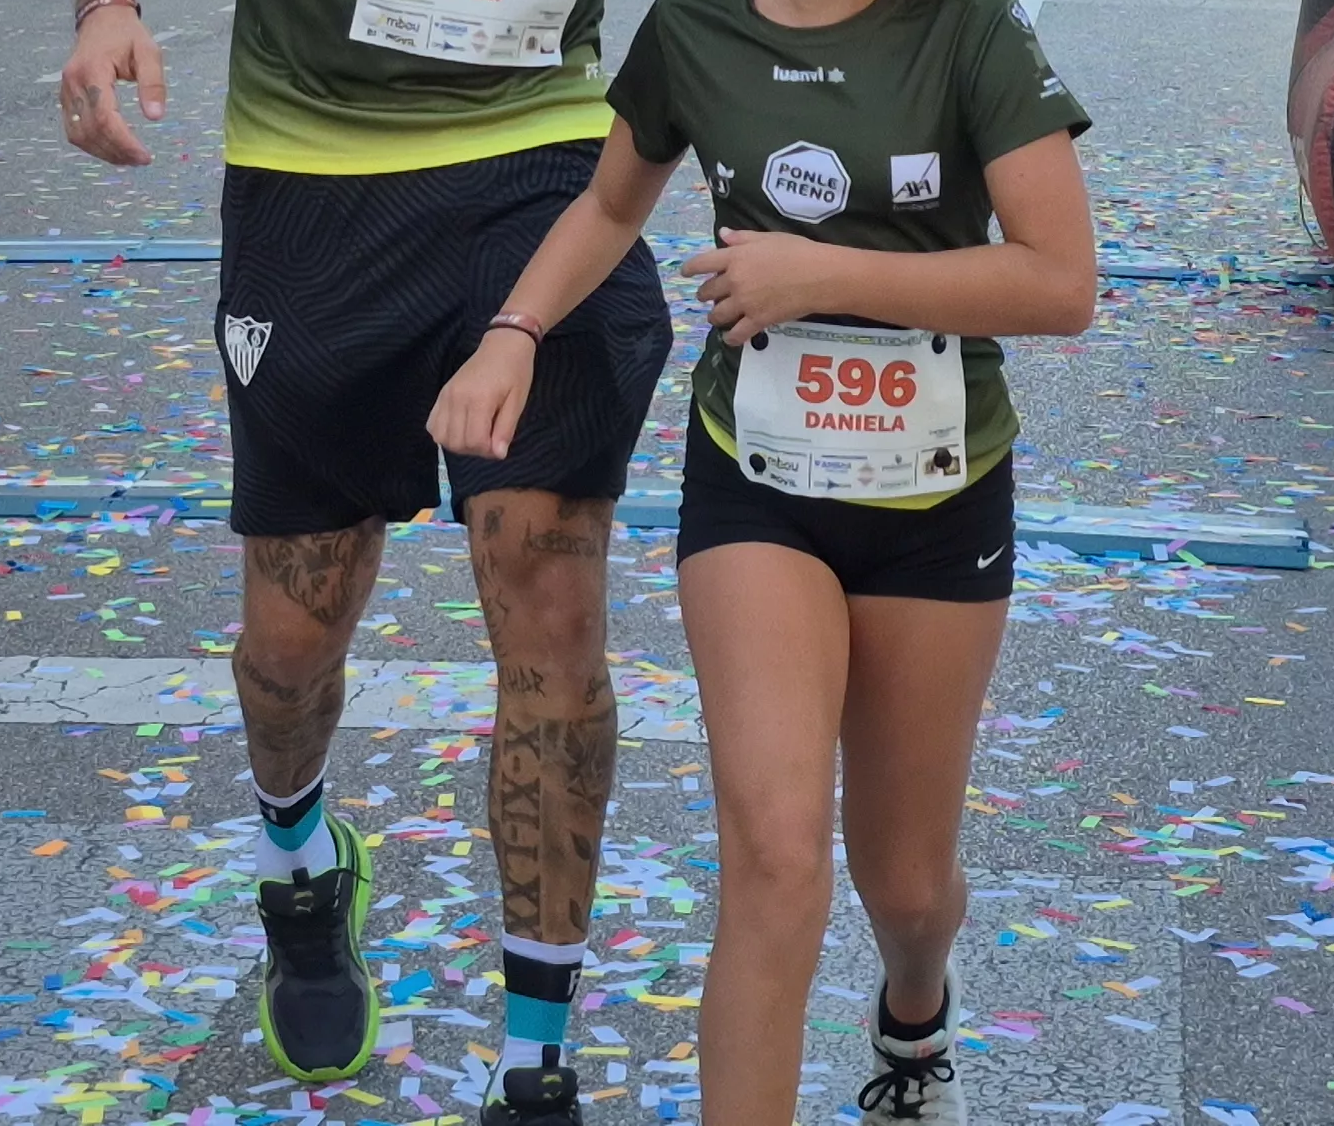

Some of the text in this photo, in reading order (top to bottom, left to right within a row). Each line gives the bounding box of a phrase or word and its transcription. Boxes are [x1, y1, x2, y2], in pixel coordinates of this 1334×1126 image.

[773, 64, 824, 83] luanvi
[779, 162, 839, 191] PONLE
[775, 177, 836, 204] FRENO
[893, 178, 932, 201] AXA
[796, 354, 917, 407] 596
[804, 411, 906, 433] DANIELA
